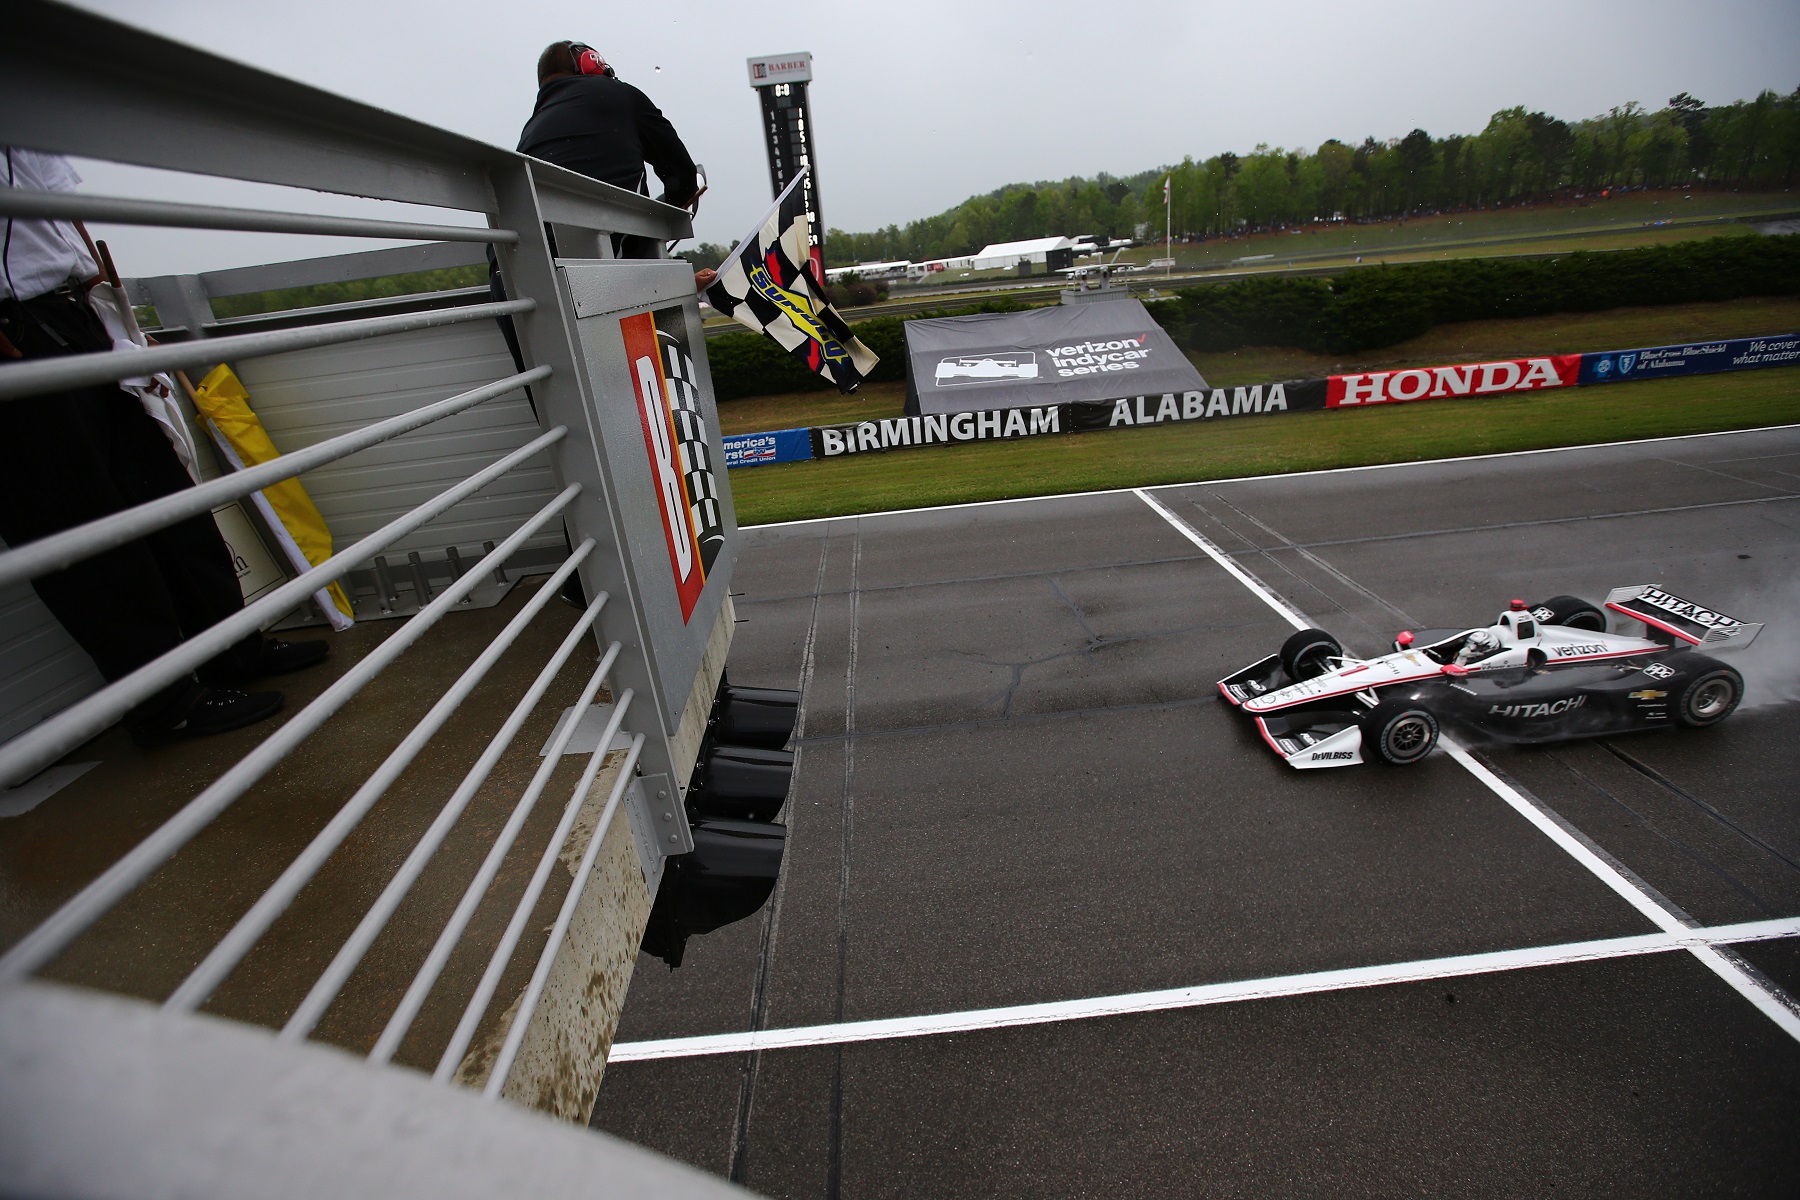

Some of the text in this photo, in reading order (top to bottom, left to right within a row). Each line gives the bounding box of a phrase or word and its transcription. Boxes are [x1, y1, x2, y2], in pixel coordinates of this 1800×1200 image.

[768, 60, 806, 71] BARBER
[770, 110, 775, 120] 1
[771, 123, 777, 133] 2
[773, 130, 806, 144] 3 5
[774, 147, 780, 156] 4
[1045, 338, 1140, 357] verizon
[1749, 340, 1798, 353] We cover
[1052, 348, 1149, 367] indycar
[1637, 359, 1649, 369] of
[1733, 350, 1800, 365] what matter
[1058, 361, 1140, 377] series
[1339, 358, 1564, 405] HONDA
[1109, 383, 1288, 427] ALABAMA
[822, 405, 1060, 456] BIRMINGHAM
[723, 436, 776, 450] merica's
[725, 449, 744, 460] rst
[1641, 587, 1746, 632] HITACHI
[1552, 642, 1608, 658] verizon
[1488, 695, 1588, 718] HITACHI
[1311, 751, 1354, 761] DeVILBISS
